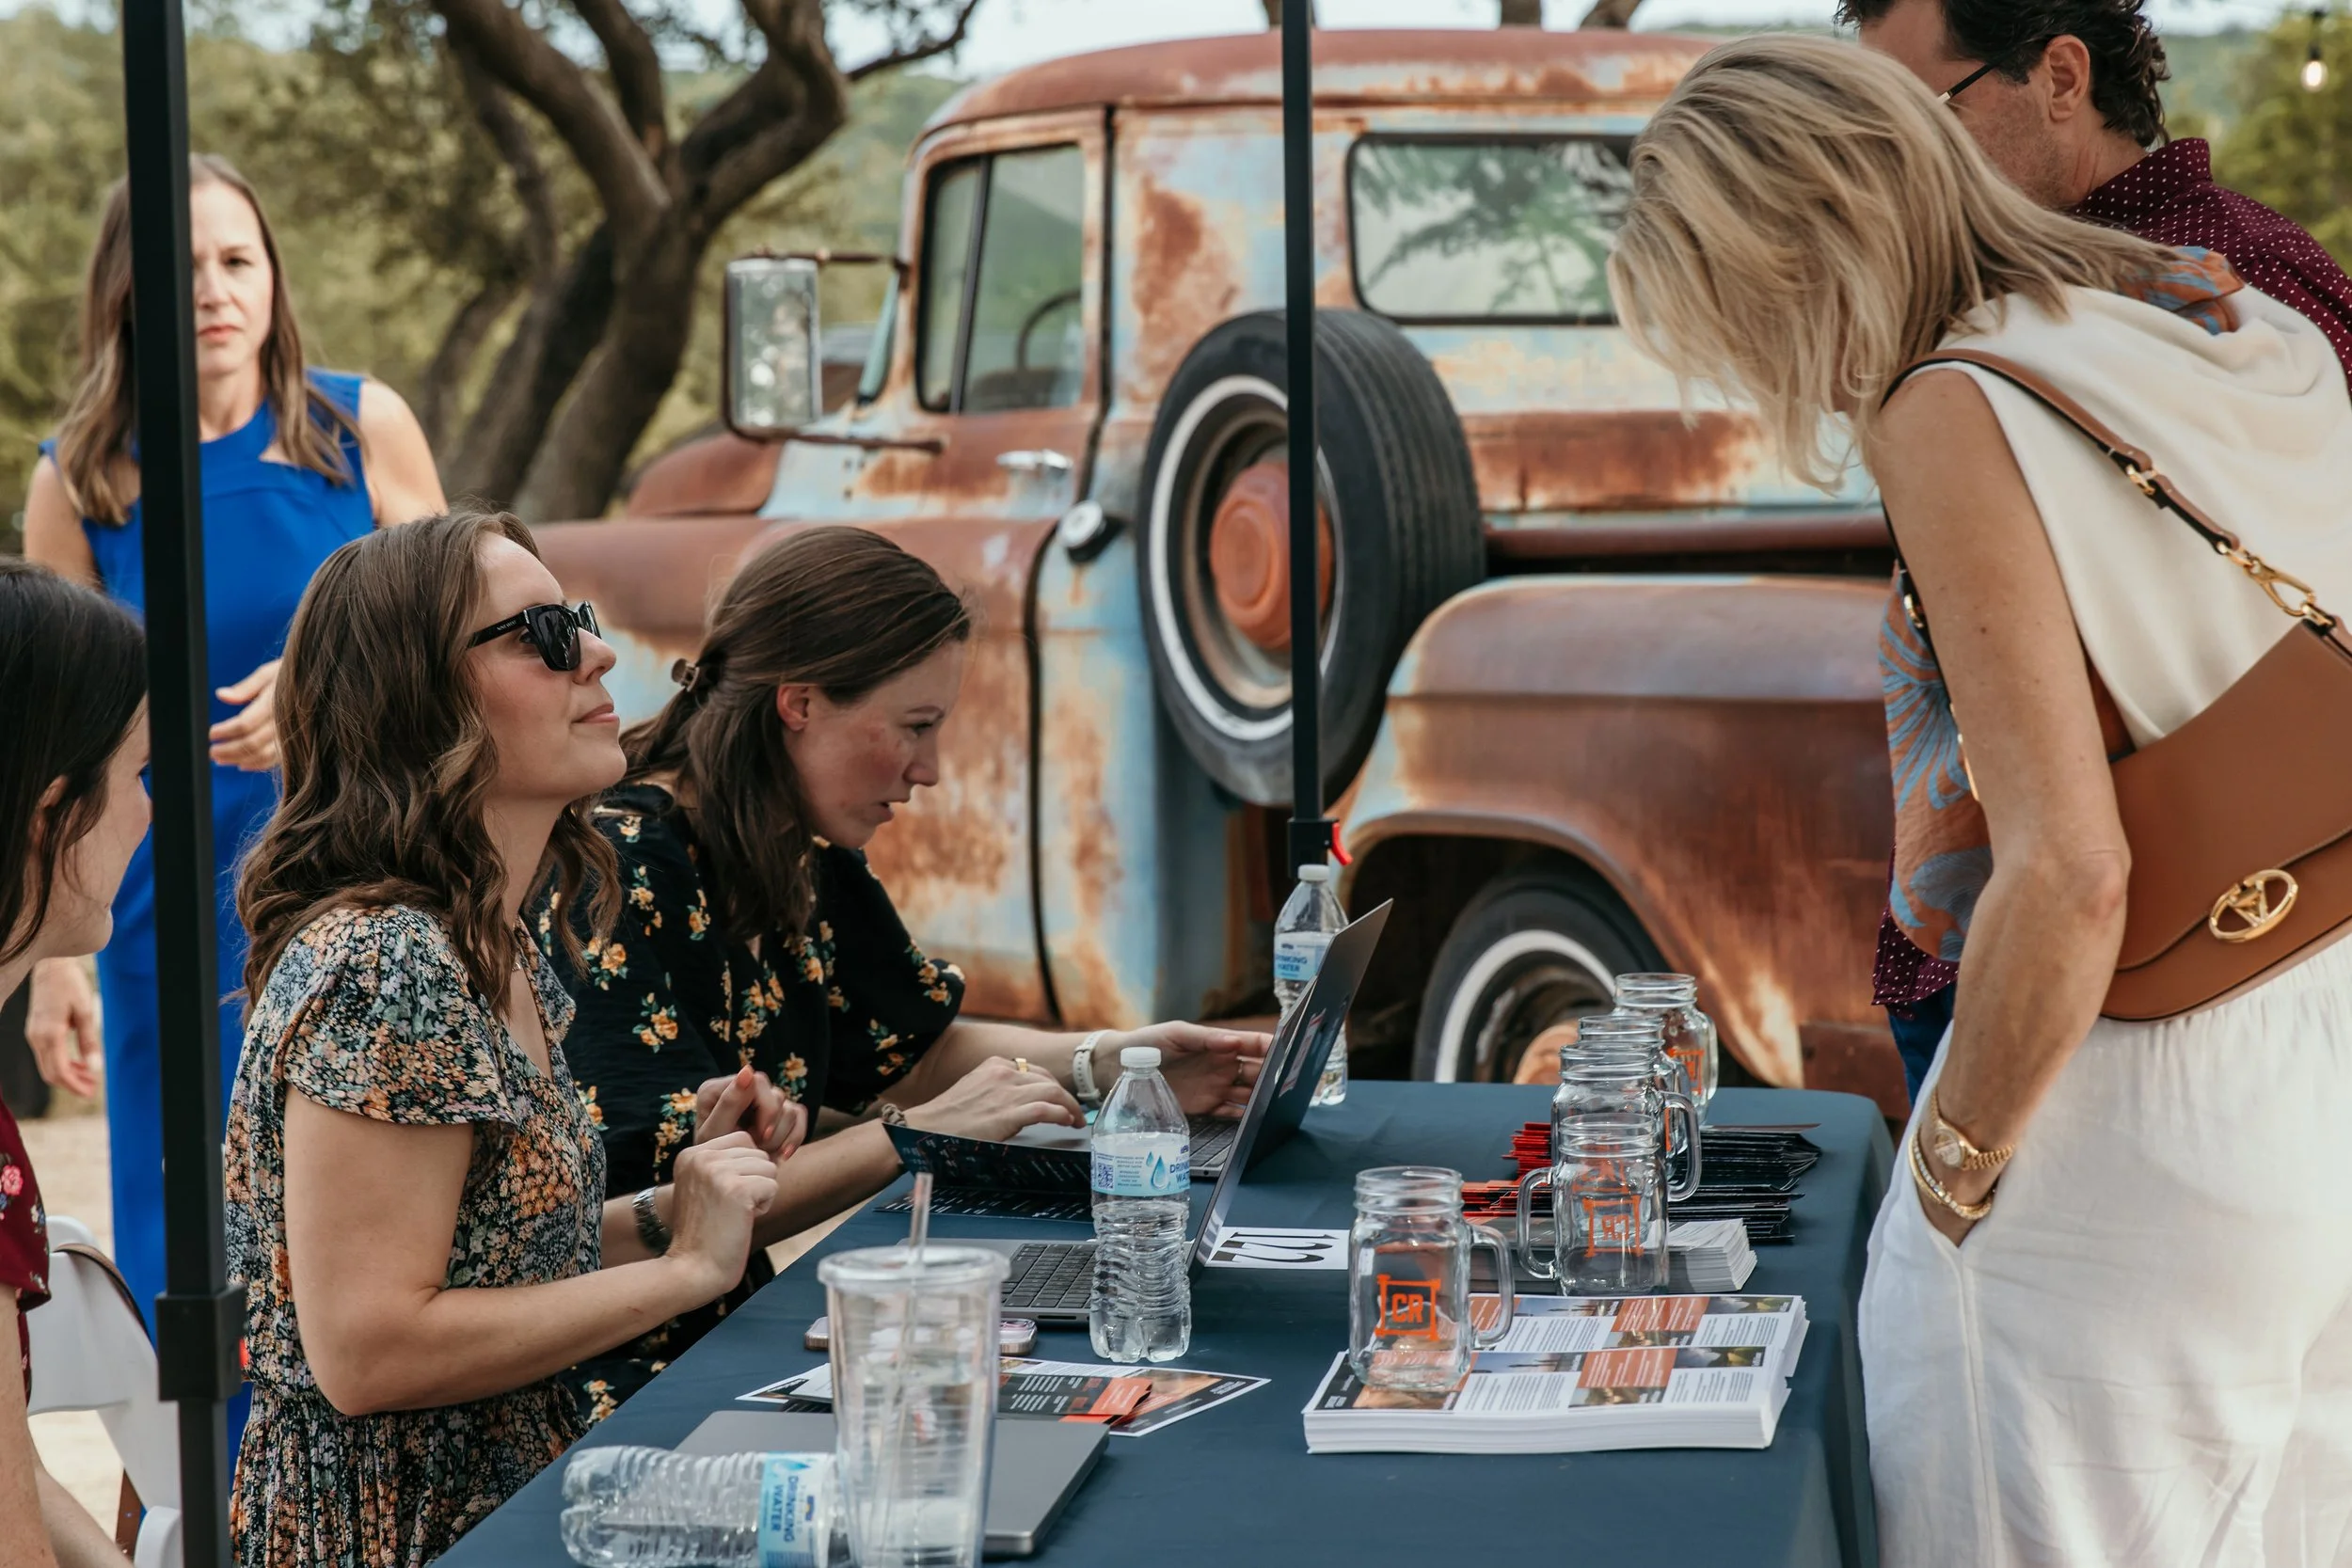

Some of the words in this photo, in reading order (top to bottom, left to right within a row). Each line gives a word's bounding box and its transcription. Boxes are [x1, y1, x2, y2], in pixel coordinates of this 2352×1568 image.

[1391, 1292, 1424, 1323] CR
[771, 1484, 783, 1531] WATER
[784, 1476, 799, 1542] DRINKING
